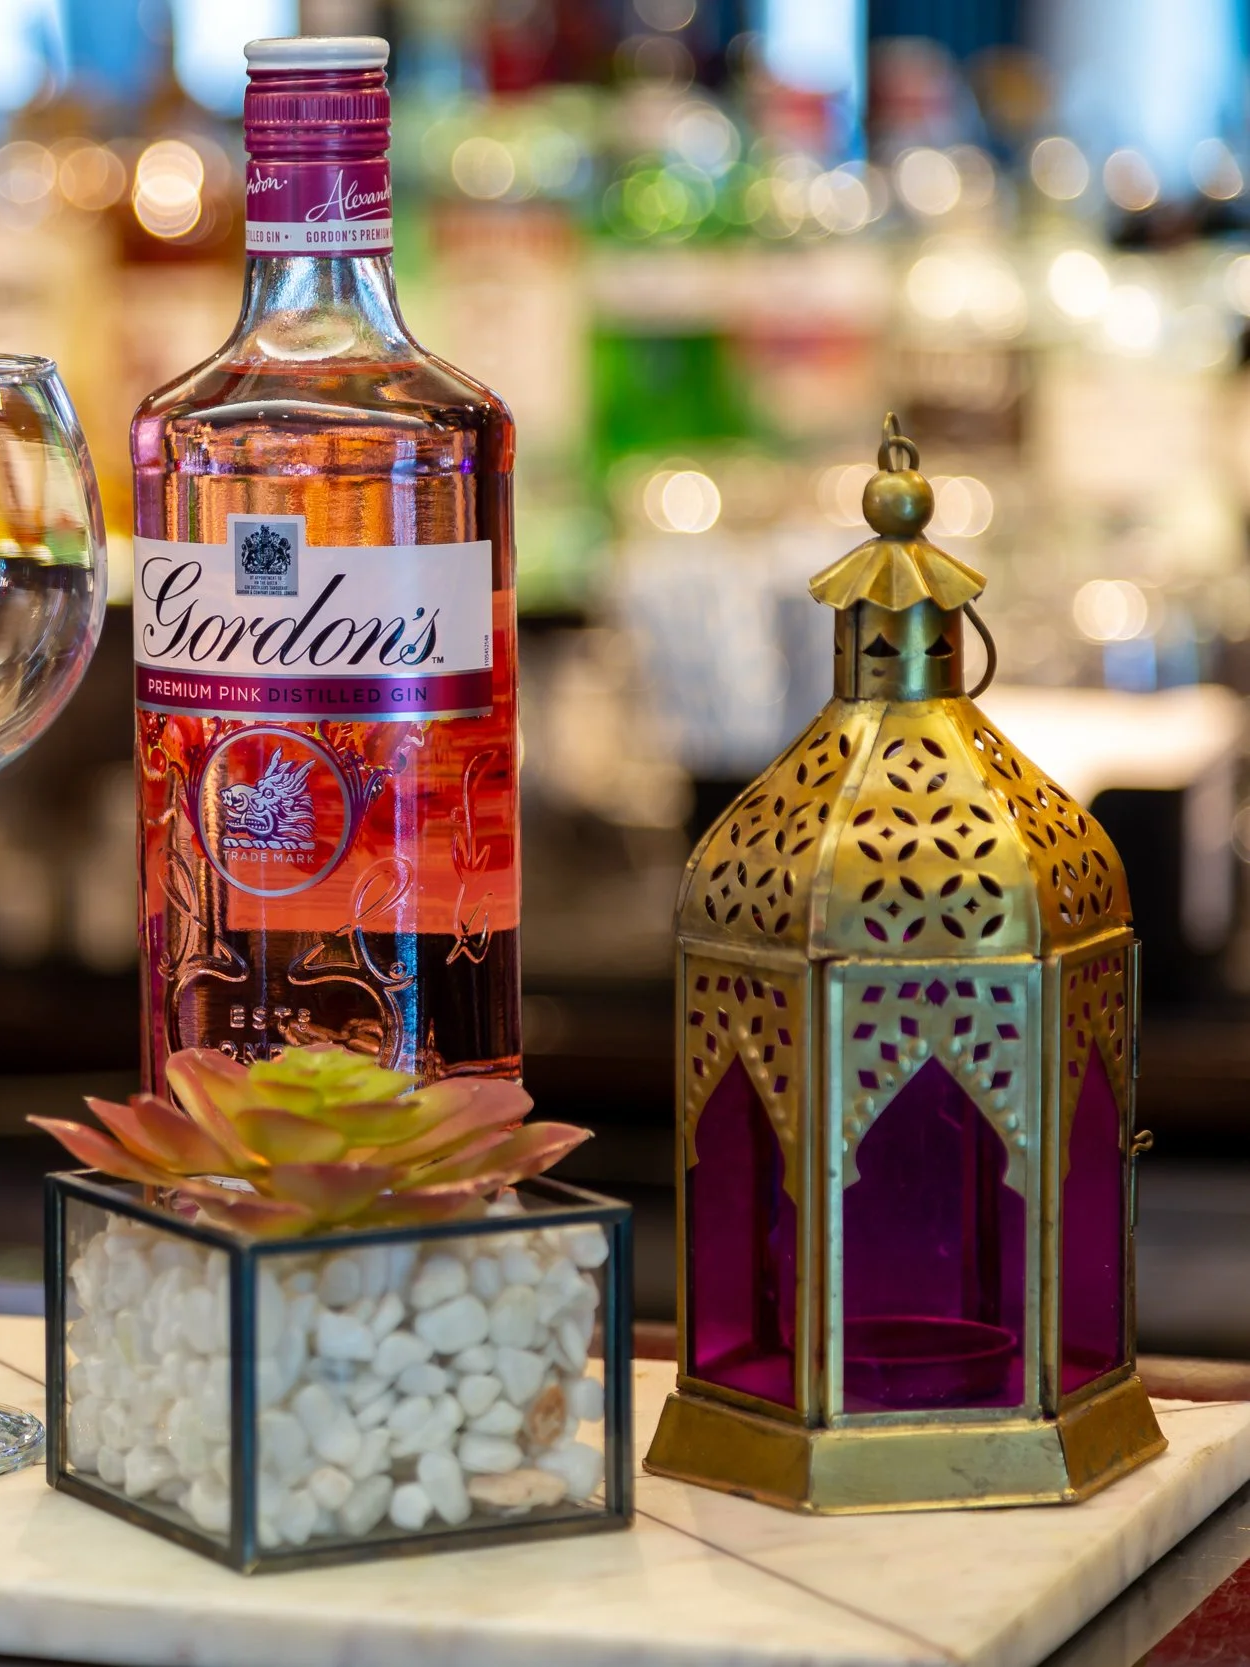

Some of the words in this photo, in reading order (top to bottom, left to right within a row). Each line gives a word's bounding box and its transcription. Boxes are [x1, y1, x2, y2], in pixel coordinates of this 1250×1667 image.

[267, 231, 280, 242] GIN
[306, 230, 357, 242] GORDON'S
[142, 556, 440, 666] Gordon's
[148, 678, 212, 700] PREMIUM
[219, 686, 262, 702] PINK
[268, 688, 381, 703] DISTILLED
[390, 687, 428, 702] GIN
[222, 850, 268, 863] TRADE
[273, 853, 315, 864] MARK
